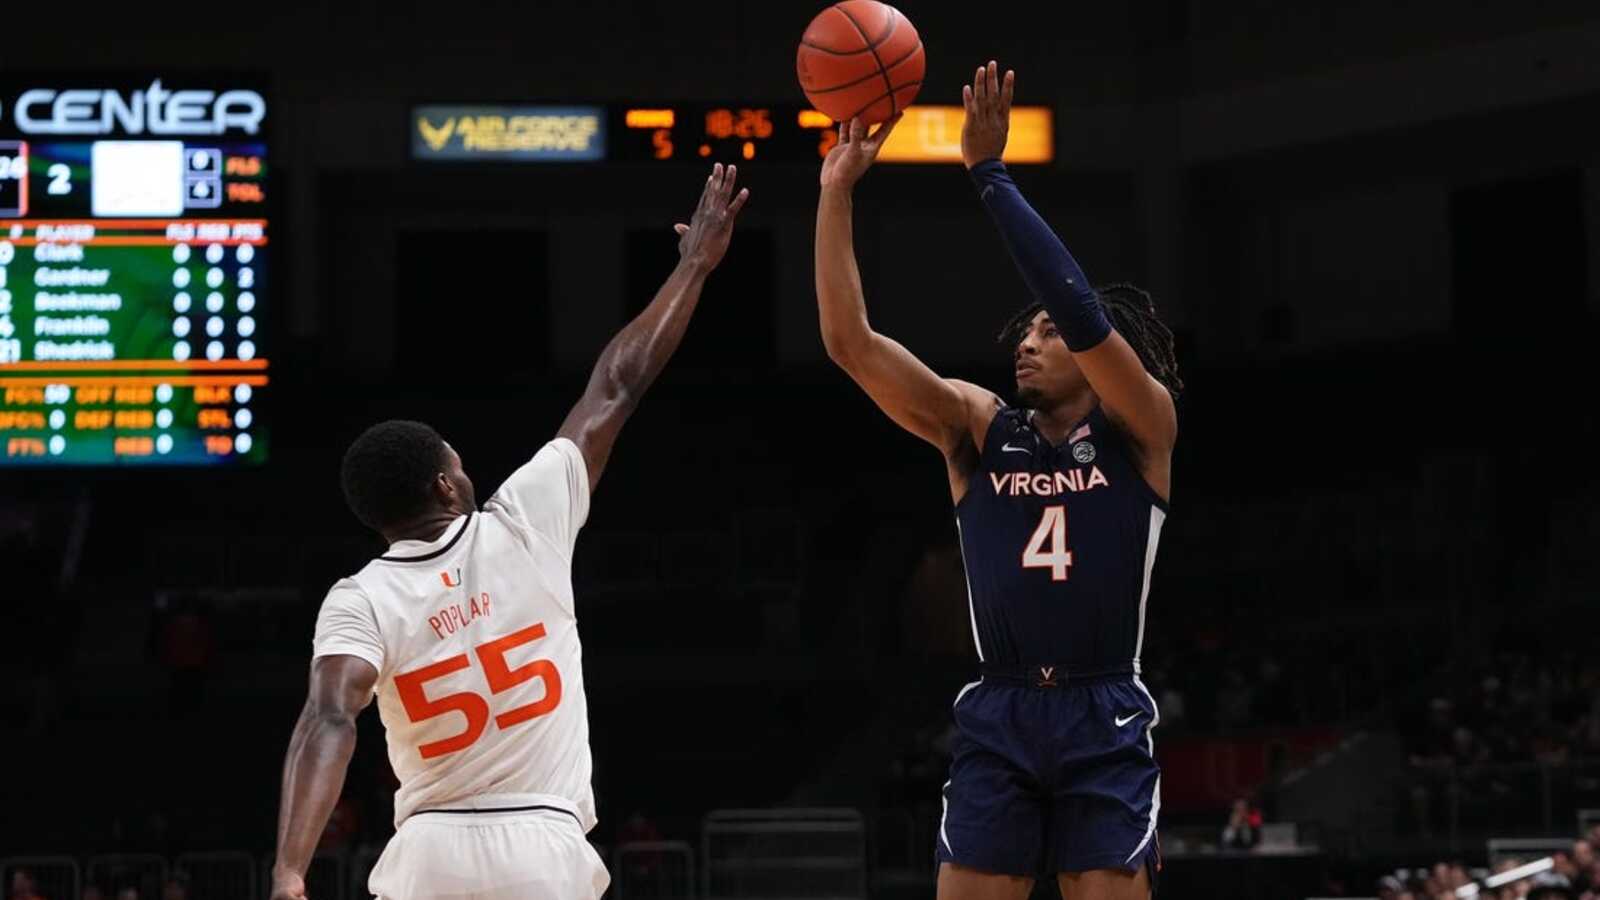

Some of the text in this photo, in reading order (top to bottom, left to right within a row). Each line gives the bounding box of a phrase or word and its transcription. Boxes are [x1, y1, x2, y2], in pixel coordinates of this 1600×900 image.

[508, 115, 598, 134] FORCE
[463, 134, 588, 151] RESERVE
[47, 163, 72, 195] 2
[34, 241, 84, 262] Clark
[172, 243, 191, 264] 0
[205, 243, 224, 264] 0
[236, 243, 255, 264] 0
[34, 266, 110, 286] Gardner
[172, 267, 191, 288] 0
[205, 267, 224, 288] 0
[236, 267, 255, 288] 2
[172, 292, 191, 313] 0
[205, 292, 224, 313] 0
[236, 292, 255, 313] 0
[34, 315, 110, 336] Franklin
[172, 316, 191, 337] 0
[205, 316, 224, 337] 0
[236, 316, 255, 337] 0
[172, 341, 191, 362] 0
[205, 341, 224, 362] 0
[236, 341, 255, 362] 0
[156, 384, 173, 403] 0
[234, 383, 252, 403] 0
[49, 409, 66, 430] 0
[156, 408, 173, 429] 0
[234, 408, 252, 429] 0
[49, 434, 66, 455] 0
[156, 433, 173, 454] 0
[234, 432, 252, 454] 0
[989, 465, 1110, 497] VIRGINIA
[1020, 504, 1073, 582] 4
[428, 592, 491, 641] POPLAR
[393, 622, 563, 760] 55
